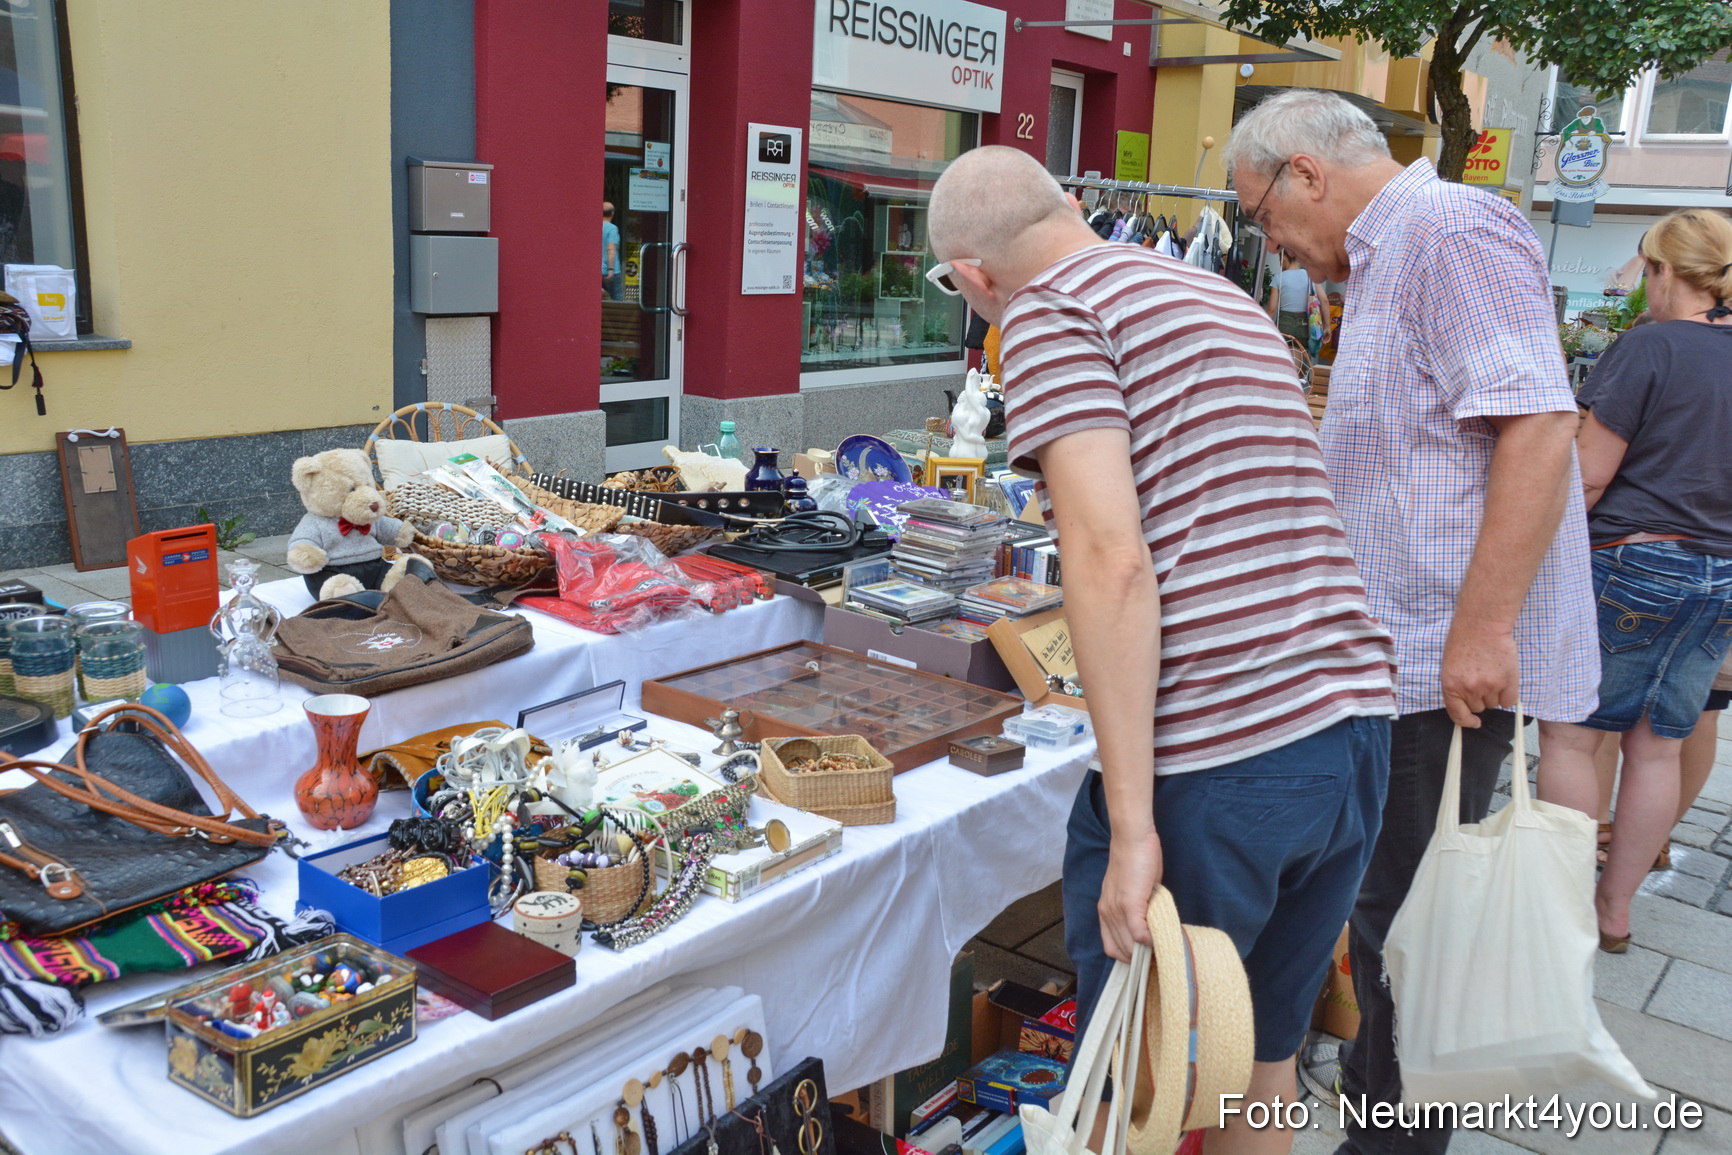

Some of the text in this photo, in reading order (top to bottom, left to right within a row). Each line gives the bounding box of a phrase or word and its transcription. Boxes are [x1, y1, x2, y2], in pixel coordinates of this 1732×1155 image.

[829, 0, 998, 66] REISSINGER
[952, 65, 994, 91] OPTIK
[1016, 112, 1035, 140] 22
[1464, 158, 1501, 171] OTTO
[1561, 149, 1601, 169] Glossner
[751, 170, 797, 183] REISSINGER
[1463, 173, 1489, 182] Bayern
[749, 200, 795, 210] Brillen Contactlinsen
